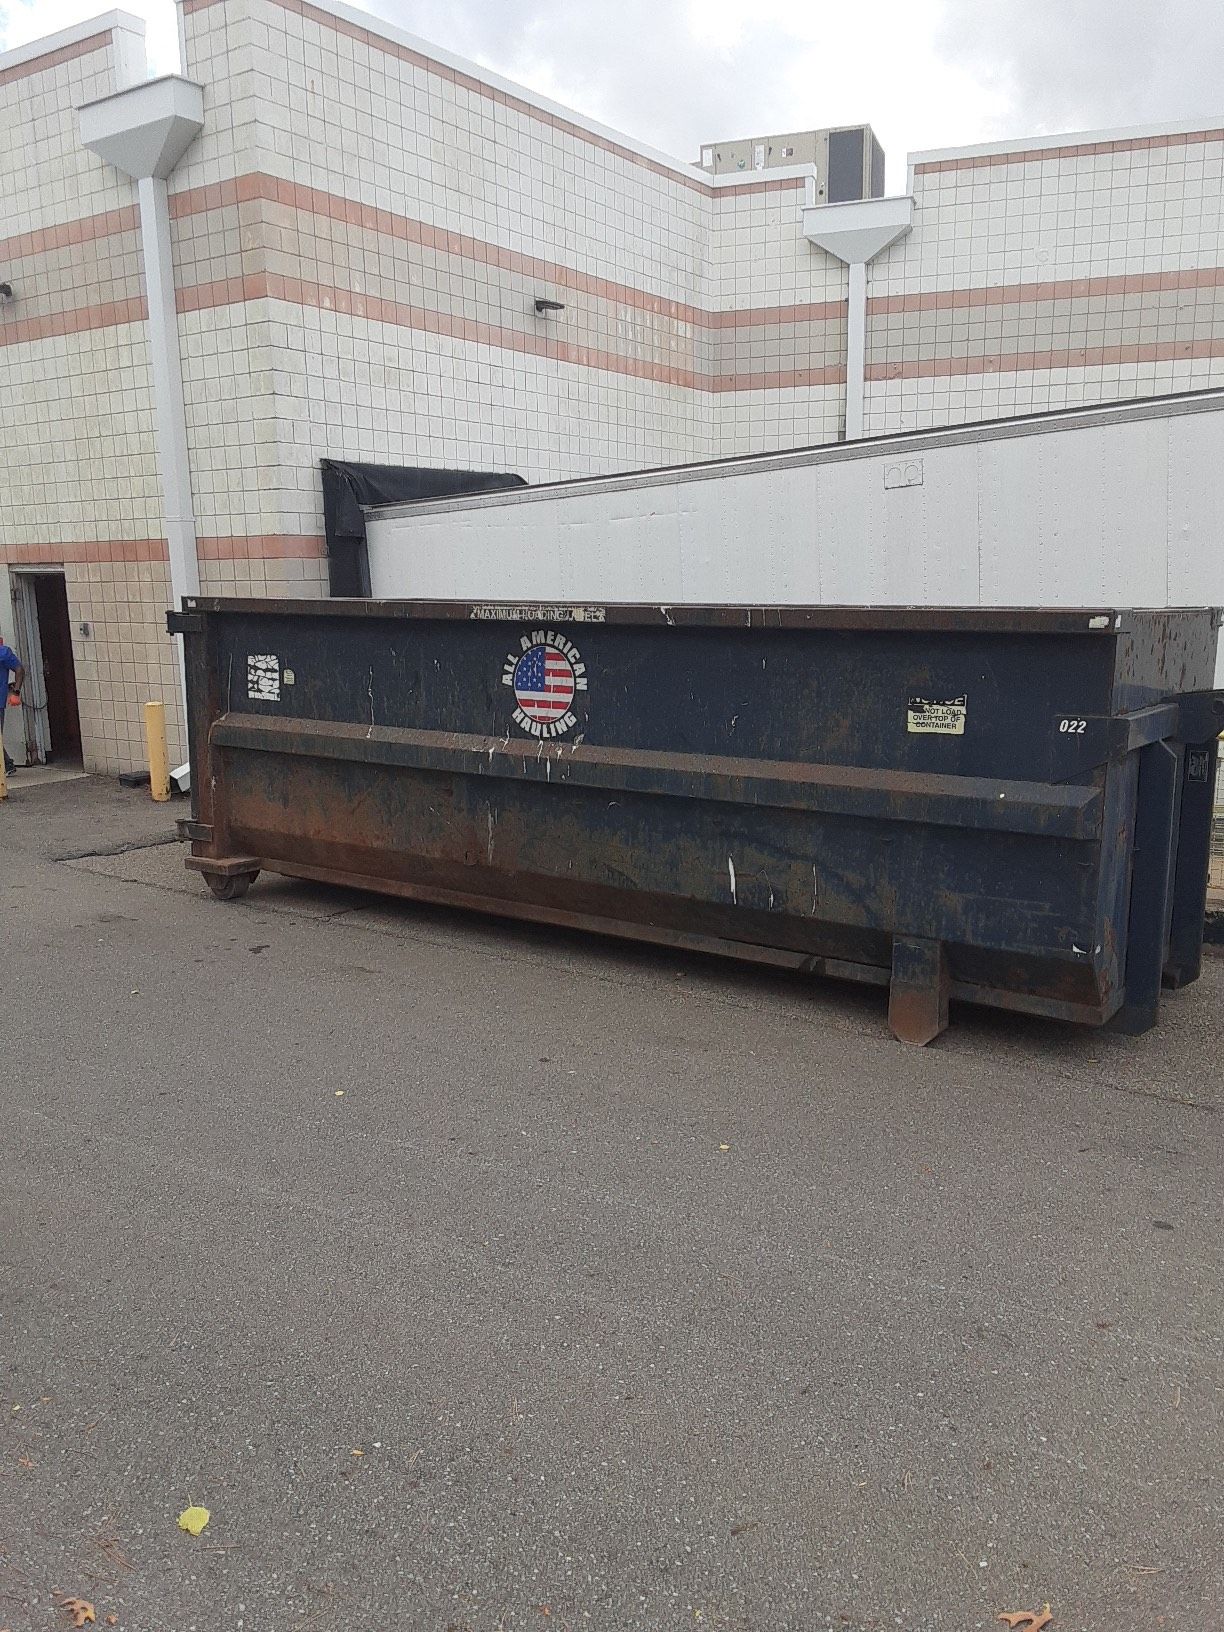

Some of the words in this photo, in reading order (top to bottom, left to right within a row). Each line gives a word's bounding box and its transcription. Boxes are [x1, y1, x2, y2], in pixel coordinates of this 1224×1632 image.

[479, 608, 520, 620] MAXIMUM
[502, 653, 519, 686] ALL
[519, 630, 588, 691] AMERICAN
[942, 708, 962, 716] LOAD
[512, 708, 577, 738] HAULING
[1060, 720, 1087, 733] 022
